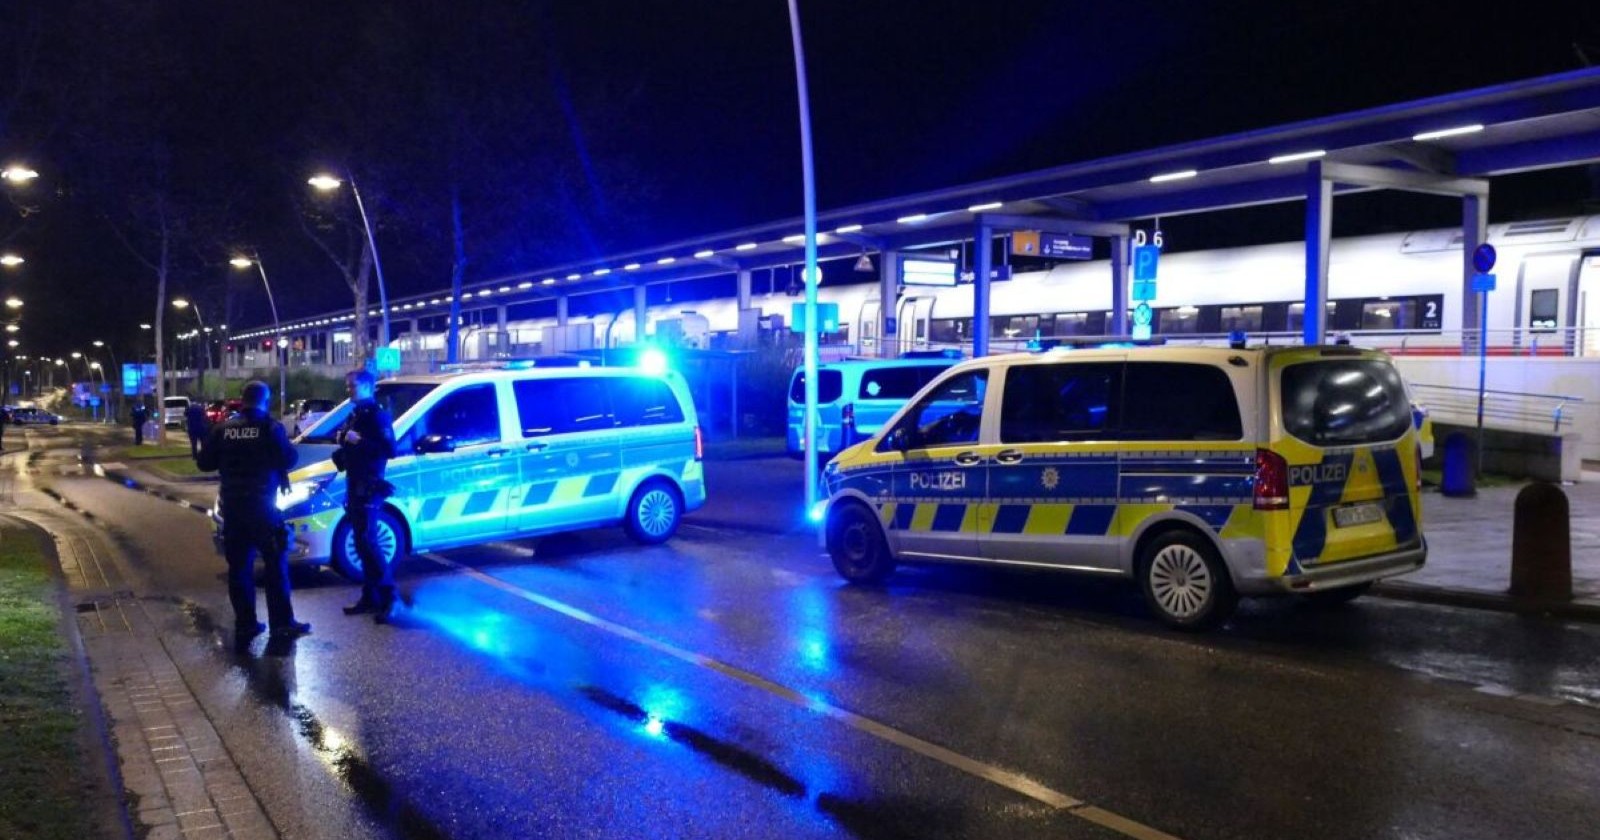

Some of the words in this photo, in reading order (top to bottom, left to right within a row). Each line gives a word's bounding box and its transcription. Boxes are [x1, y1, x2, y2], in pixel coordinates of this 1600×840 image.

[1135, 229, 1147, 247] D
[1153, 231, 1163, 248] 6
[1139, 251, 1153, 277] P
[1425, 301, 1437, 318] 2
[223, 427, 259, 440] POLIZEI
[910, 471, 966, 490] POLIZEI
[1289, 463, 1346, 484] POLIZEI
